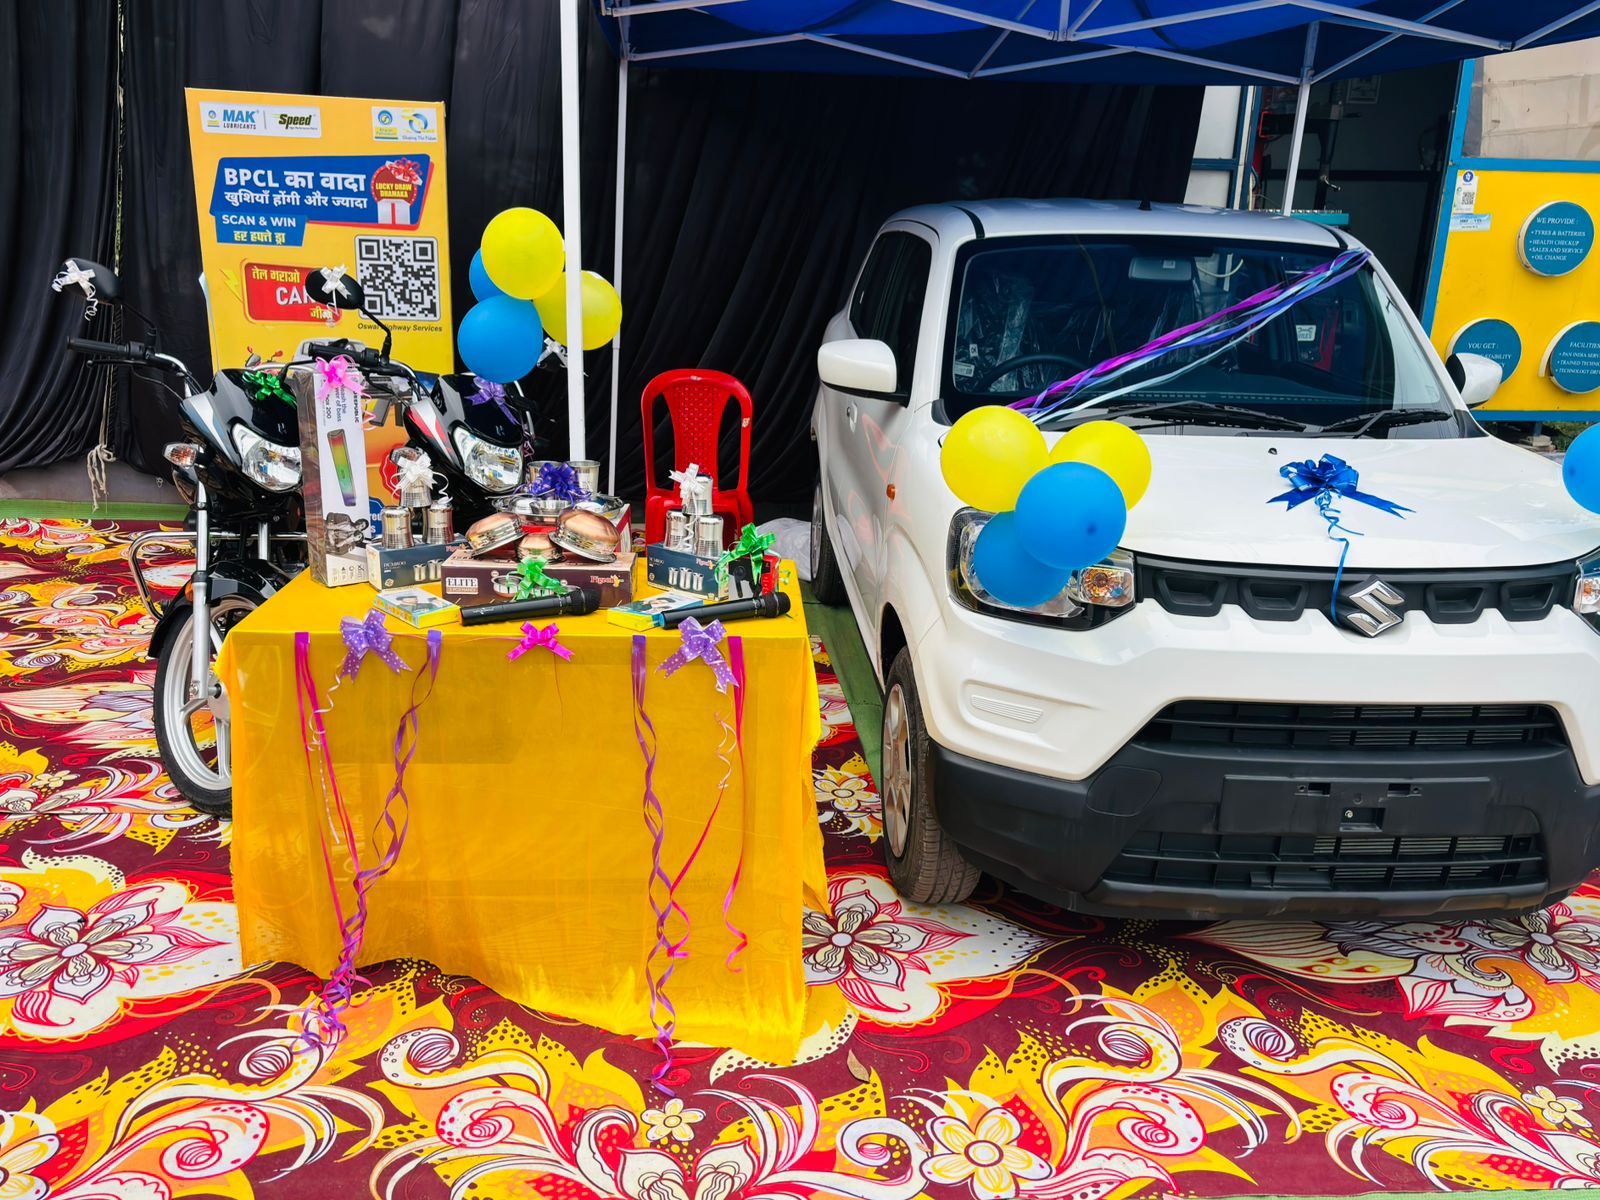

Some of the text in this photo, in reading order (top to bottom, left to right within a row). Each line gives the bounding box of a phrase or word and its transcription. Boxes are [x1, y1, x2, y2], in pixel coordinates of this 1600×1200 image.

[223, 109, 255, 123] MAK
[278, 114, 312, 130] Speed
[224, 168, 366, 192] BPCL का वादा
[375, 182, 412, 191] LUCKY DRAW
[224, 189, 367, 208] खुशियाँ होंगी और ज्यादा
[380, 190, 408, 198] DHAMAKA
[222, 214, 296, 228] SCAN & WIN
[1536, 216, 1575, 225] WE PROVIDE
[233, 230, 248, 241] हर
[252, 265, 268, 280] तेल
[412, 324, 443, 332] Services
[447, 578, 477, 587] ELITE
